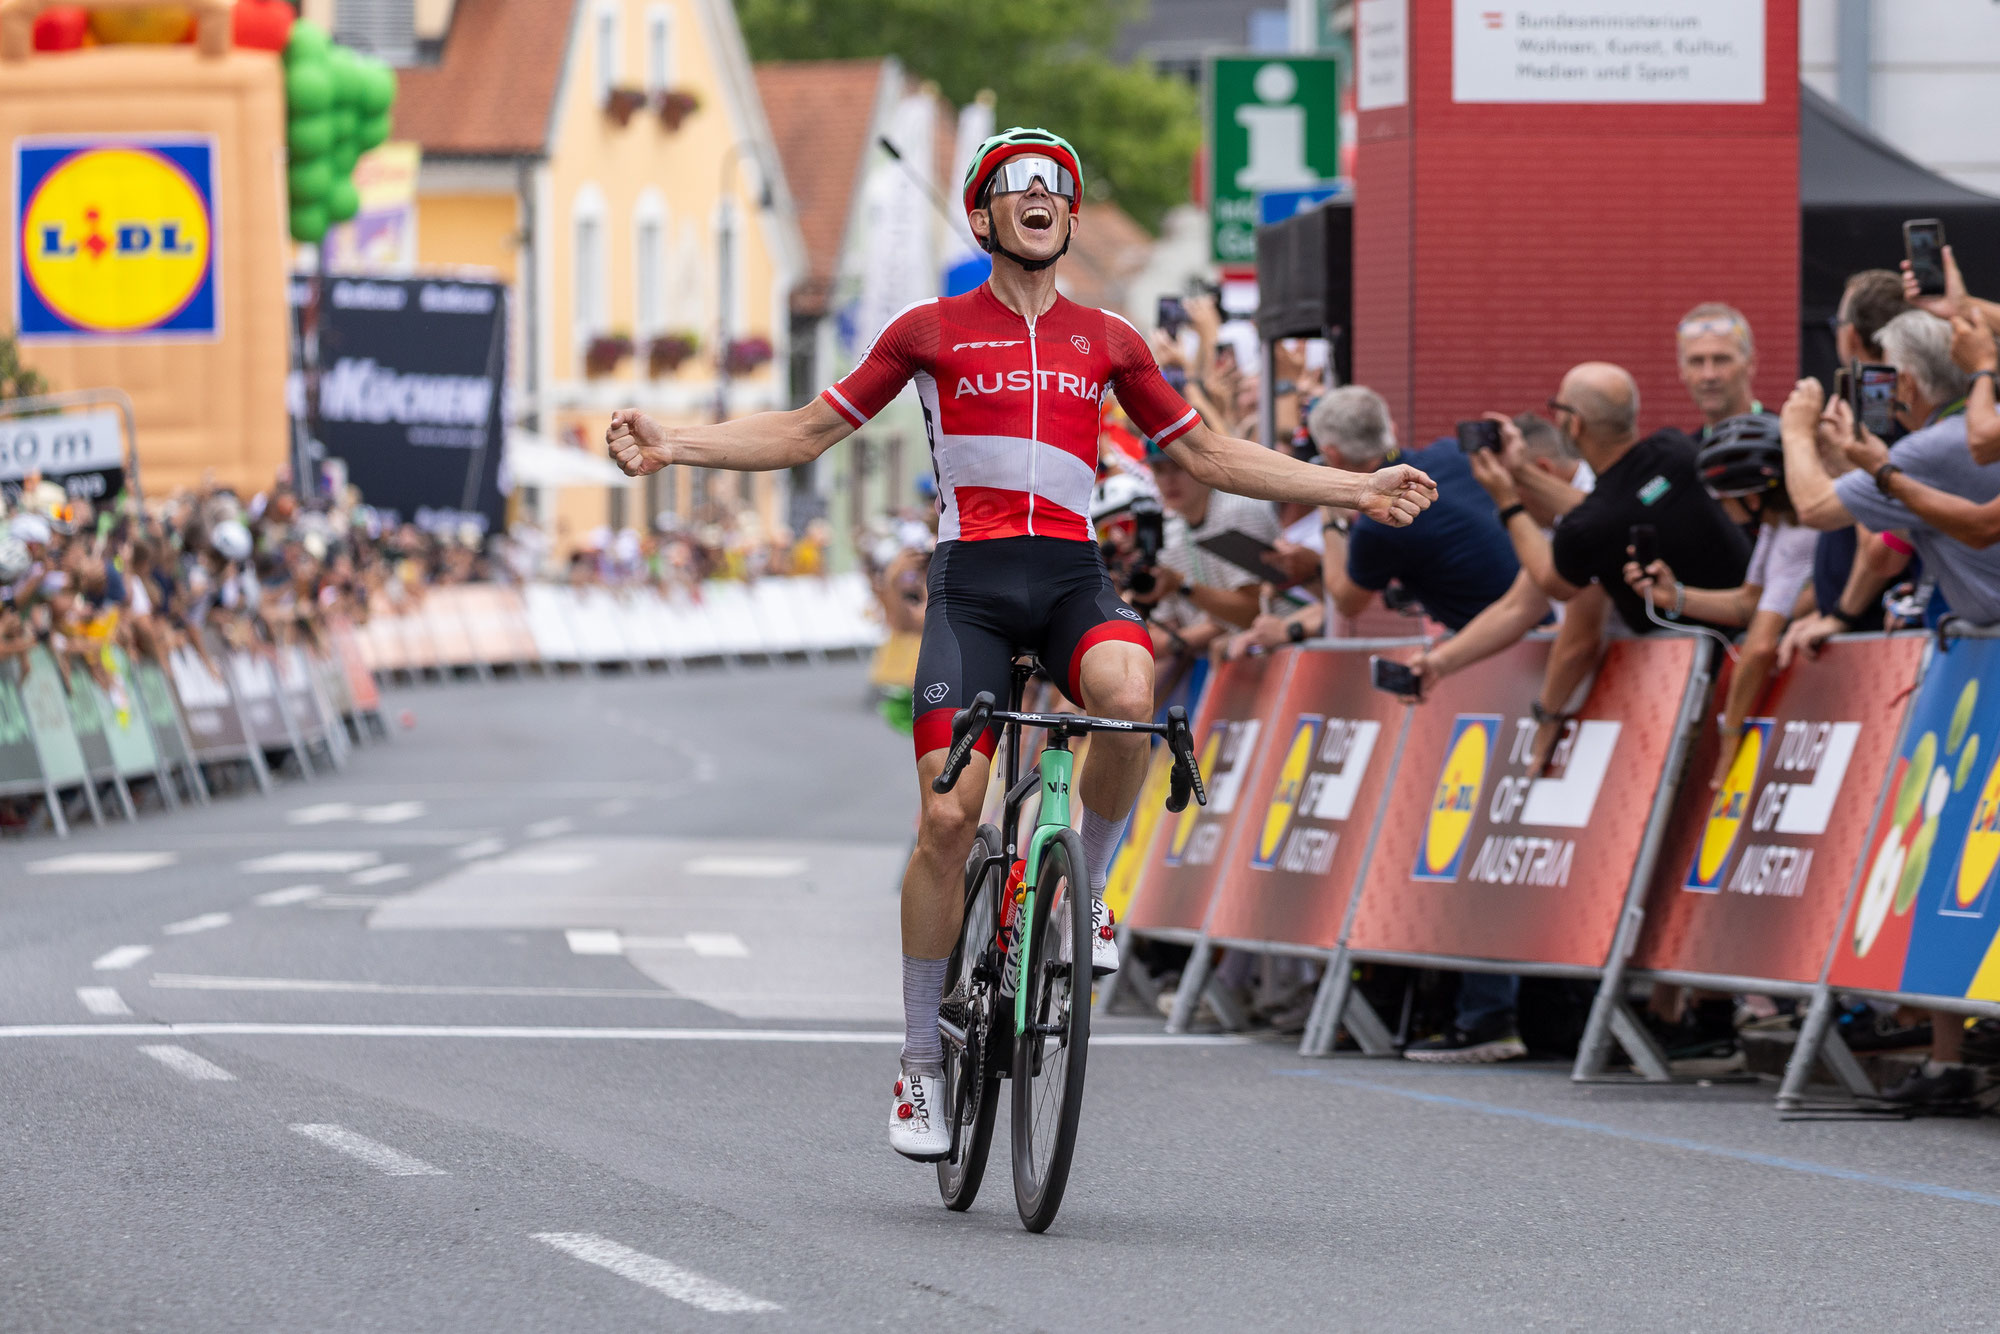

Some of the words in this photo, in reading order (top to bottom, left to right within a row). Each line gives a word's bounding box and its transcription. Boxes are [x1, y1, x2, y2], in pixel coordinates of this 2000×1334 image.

[1516, 11, 1701, 31] Bundesministerium
[1516, 38, 1602, 58] Wohnen,
[1606, 37, 1669, 58] Kunst,
[1673, 37, 1738, 58] Kultur,
[1516, 61, 1588, 81] Medien
[1593, 62, 1631, 81] und
[1636, 63, 1690, 85] Sport
[952, 340, 1025, 353] FELT
[954, 370, 1099, 404] AUSTRIA
[1508, 717, 1579, 766] TOR
[1774, 720, 1833, 771] TOUR
[1489, 775, 1530, 824] OF
[1752, 781, 1789, 832] OF
[1469, 834, 1575, 888] AUSTRIA
[1728, 844, 1815, 897] AUSTRIA
